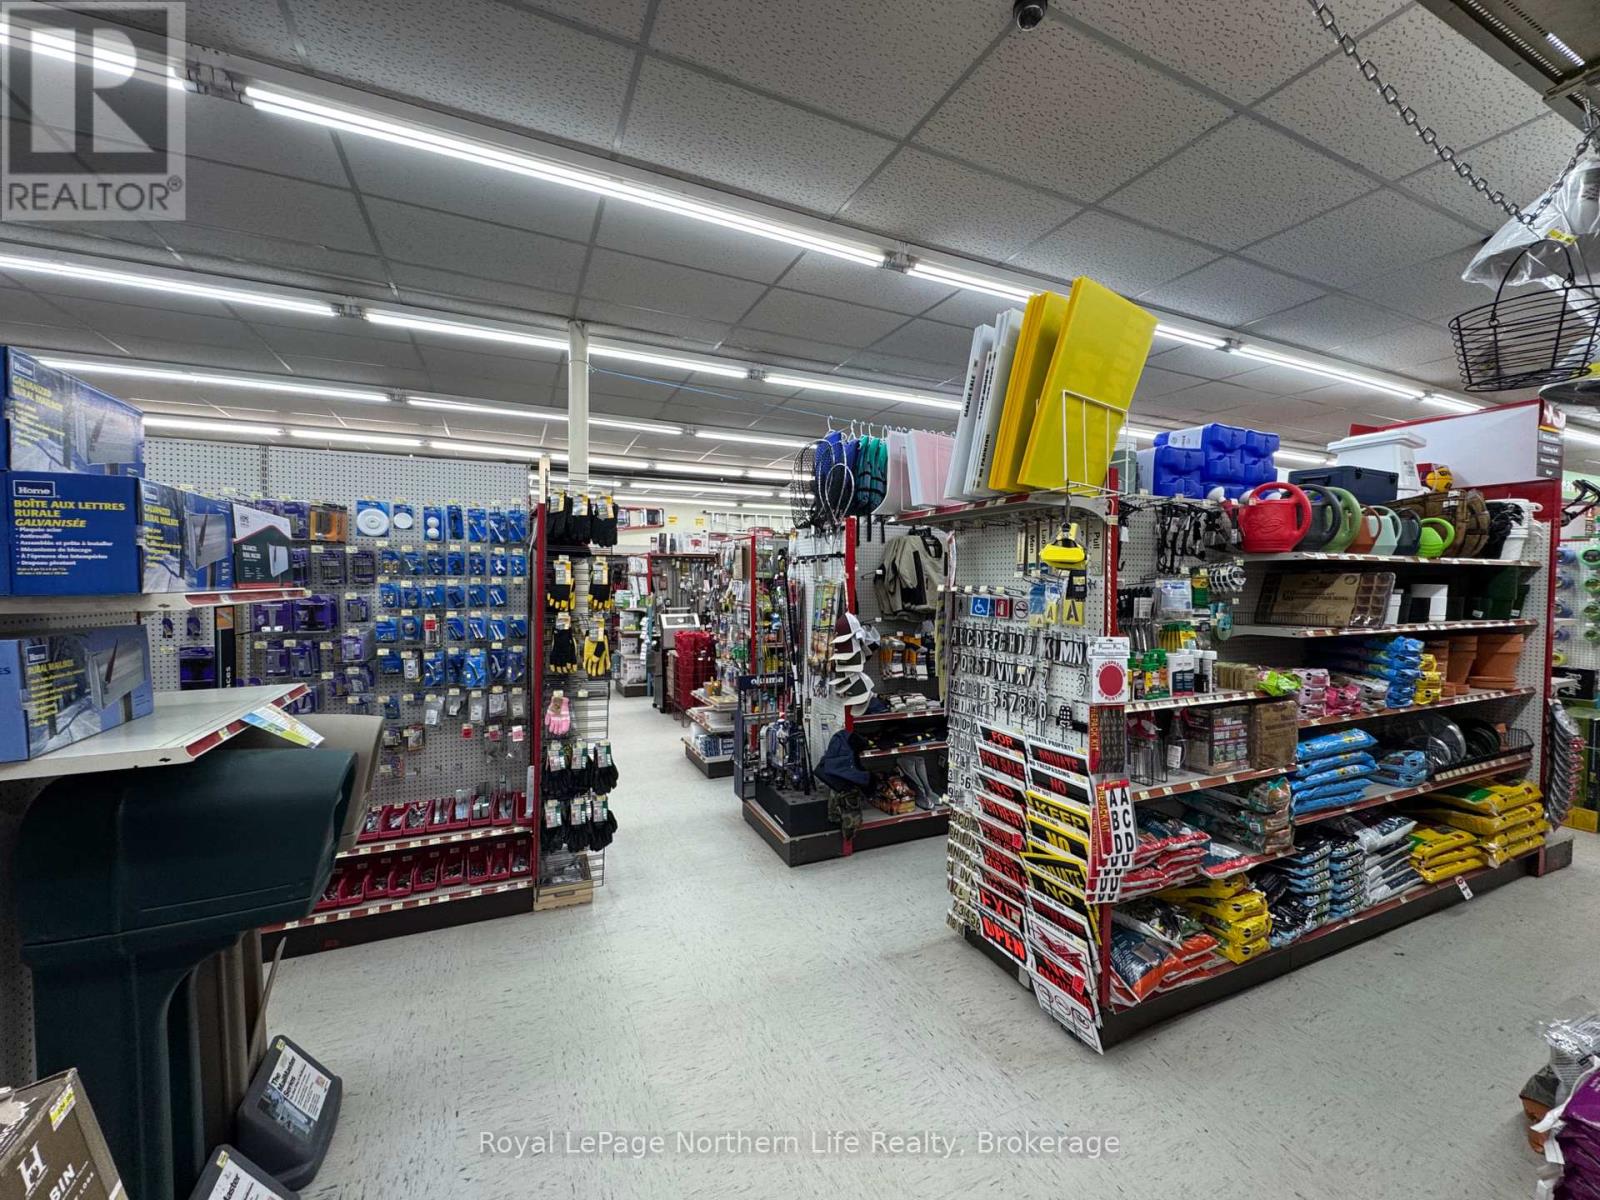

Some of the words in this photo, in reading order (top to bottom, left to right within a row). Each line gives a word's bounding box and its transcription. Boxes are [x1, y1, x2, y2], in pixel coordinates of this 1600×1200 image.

[18, 486, 51, 495] Home
[14, 498, 48, 508] BOÎTE
[51, 500, 76, 509] AUX
[78, 501, 126, 511] LETTRES
[14, 509, 61, 518] RURALE
[15, 518, 87, 528] GALVANISÉE
[1066, 600, 1079, 622] A
[1060, 640, 1073, 663] M
[1073, 641, 1083, 665] N
[1090, 707, 1098, 737] REPACK
[991, 730, 1013, 749] FOR
[1049, 776, 1067, 796] NO
[1109, 790, 1117, 808] A
[1120, 788, 1129, 805] A
[1034, 801, 1085, 827] KEEP
[1111, 810, 1120, 831] B
[1122, 809, 1131, 829] C
[1046, 830, 1070, 853] NO
[1114, 834, 1123, 854] D
[1125, 831, 1134, 851] D
[1043, 880, 1073, 906] NO
[981, 888, 1022, 925] EXI
[983, 916, 1026, 961] OPEN
